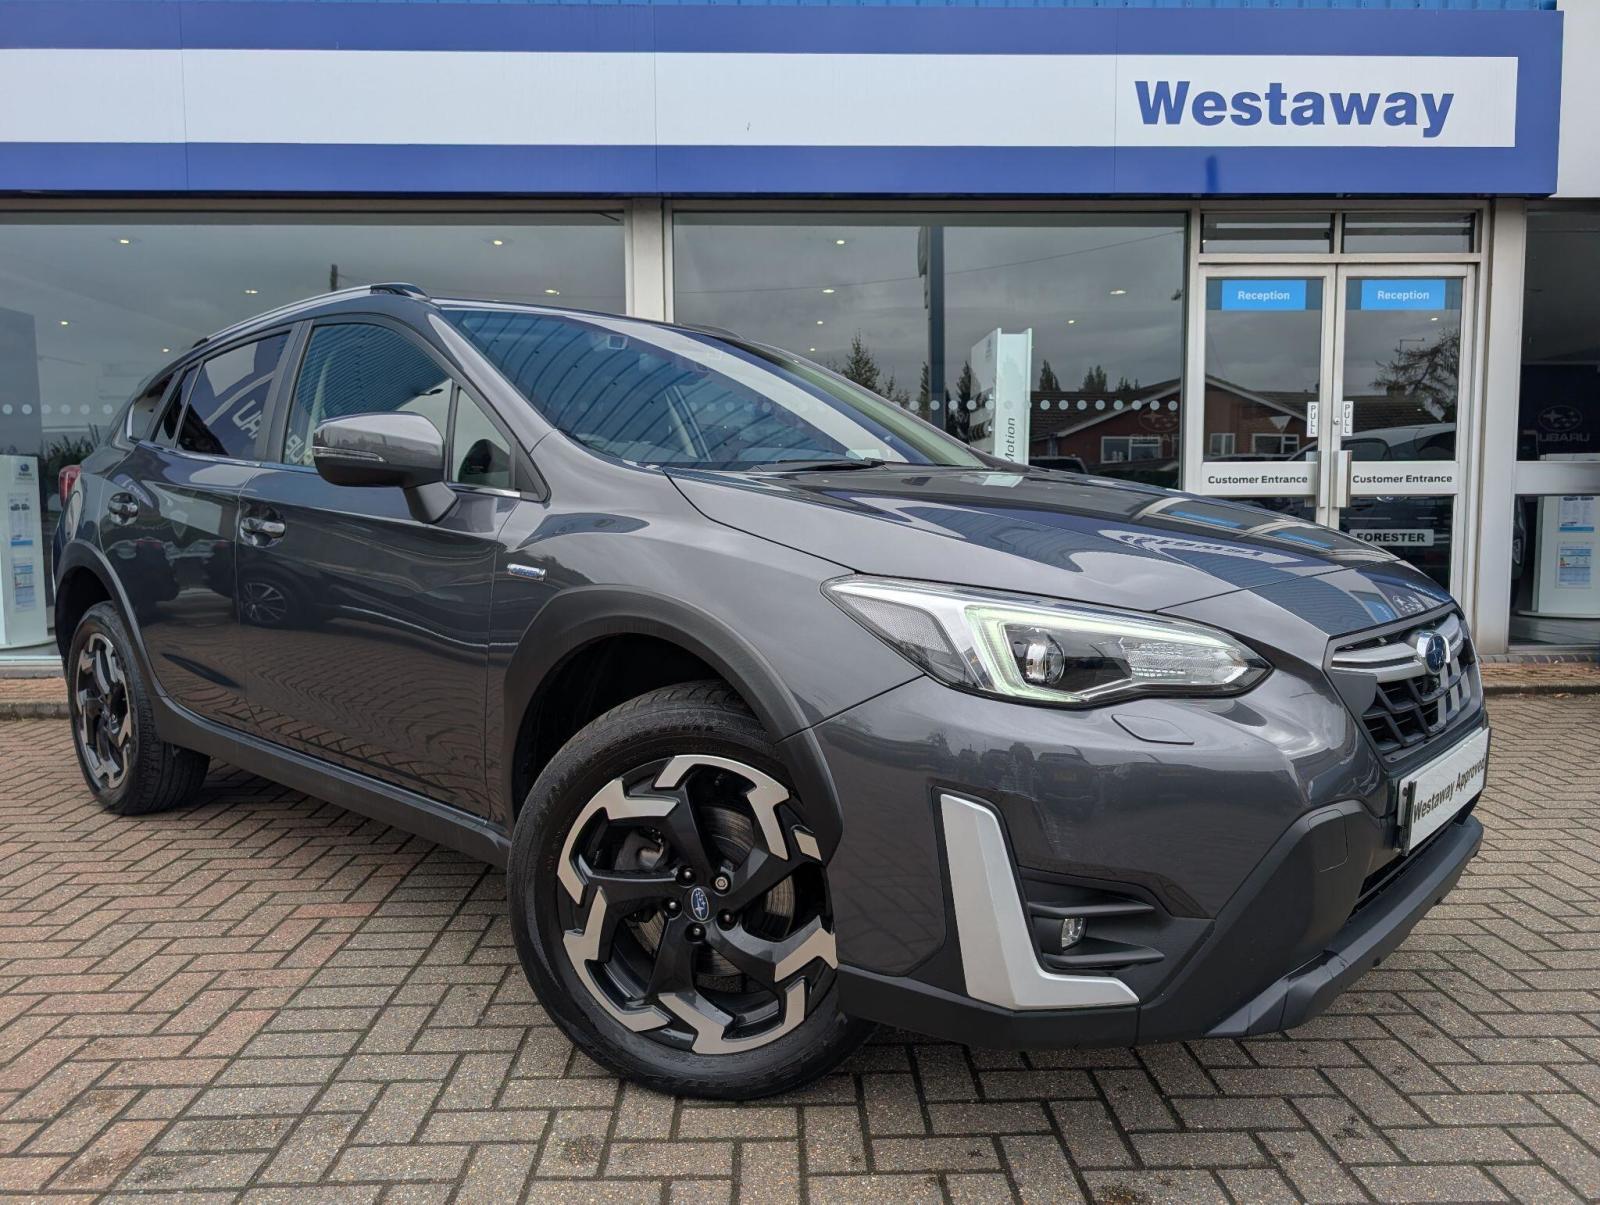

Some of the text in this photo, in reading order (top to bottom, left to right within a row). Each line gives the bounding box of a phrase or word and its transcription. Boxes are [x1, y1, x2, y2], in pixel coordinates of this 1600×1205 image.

[1134, 80, 1454, 138] Westaway
[1237, 290, 1290, 302] Reception
[1377, 290, 1430, 302] Reception
[1537, 432, 1591, 442] UBARU
[1207, 475, 1308, 484] Customer Entrance
[1352, 474, 1453, 483] Customer Entrance
[1357, 532, 1425, 543] FORESTER
[1413, 780, 1455, 823] Westaway
